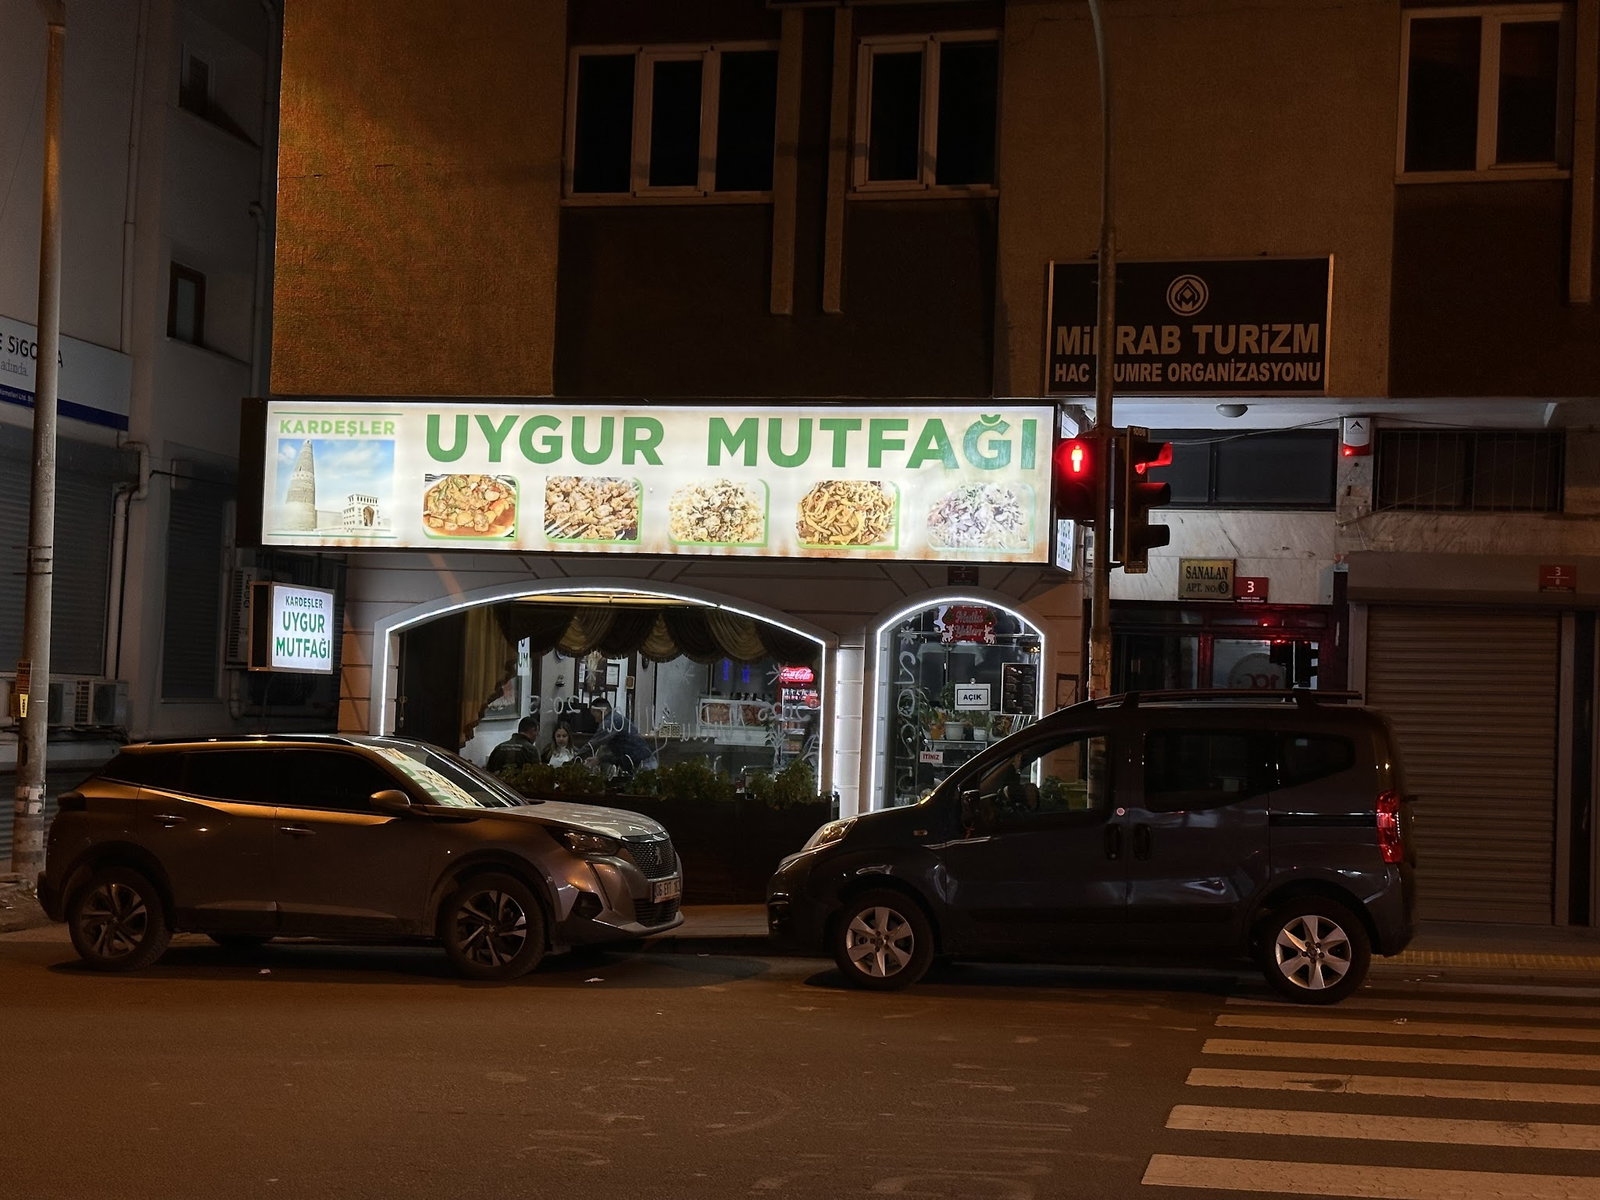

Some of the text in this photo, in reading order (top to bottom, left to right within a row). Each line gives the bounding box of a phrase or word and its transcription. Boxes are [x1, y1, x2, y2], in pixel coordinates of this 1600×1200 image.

[1192, 323, 1319, 354] TURiZM
[1055, 358, 1321, 382] HAC UMRE ORGANİZASYONU
[280, 420, 395, 437] KARDEŞLER
[426, 414, 1037, 470] UYGUR MUTFAĞI
[1185, 566, 1229, 580] SANALAN
[1247, 581, 1255, 593] 3
[285, 595, 323, 610] KARDEŞLER
[283, 611, 325, 633] UYGUR
[276, 637, 330, 659] MUTFAĞI
[963, 694, 982, 702] AÇIK
